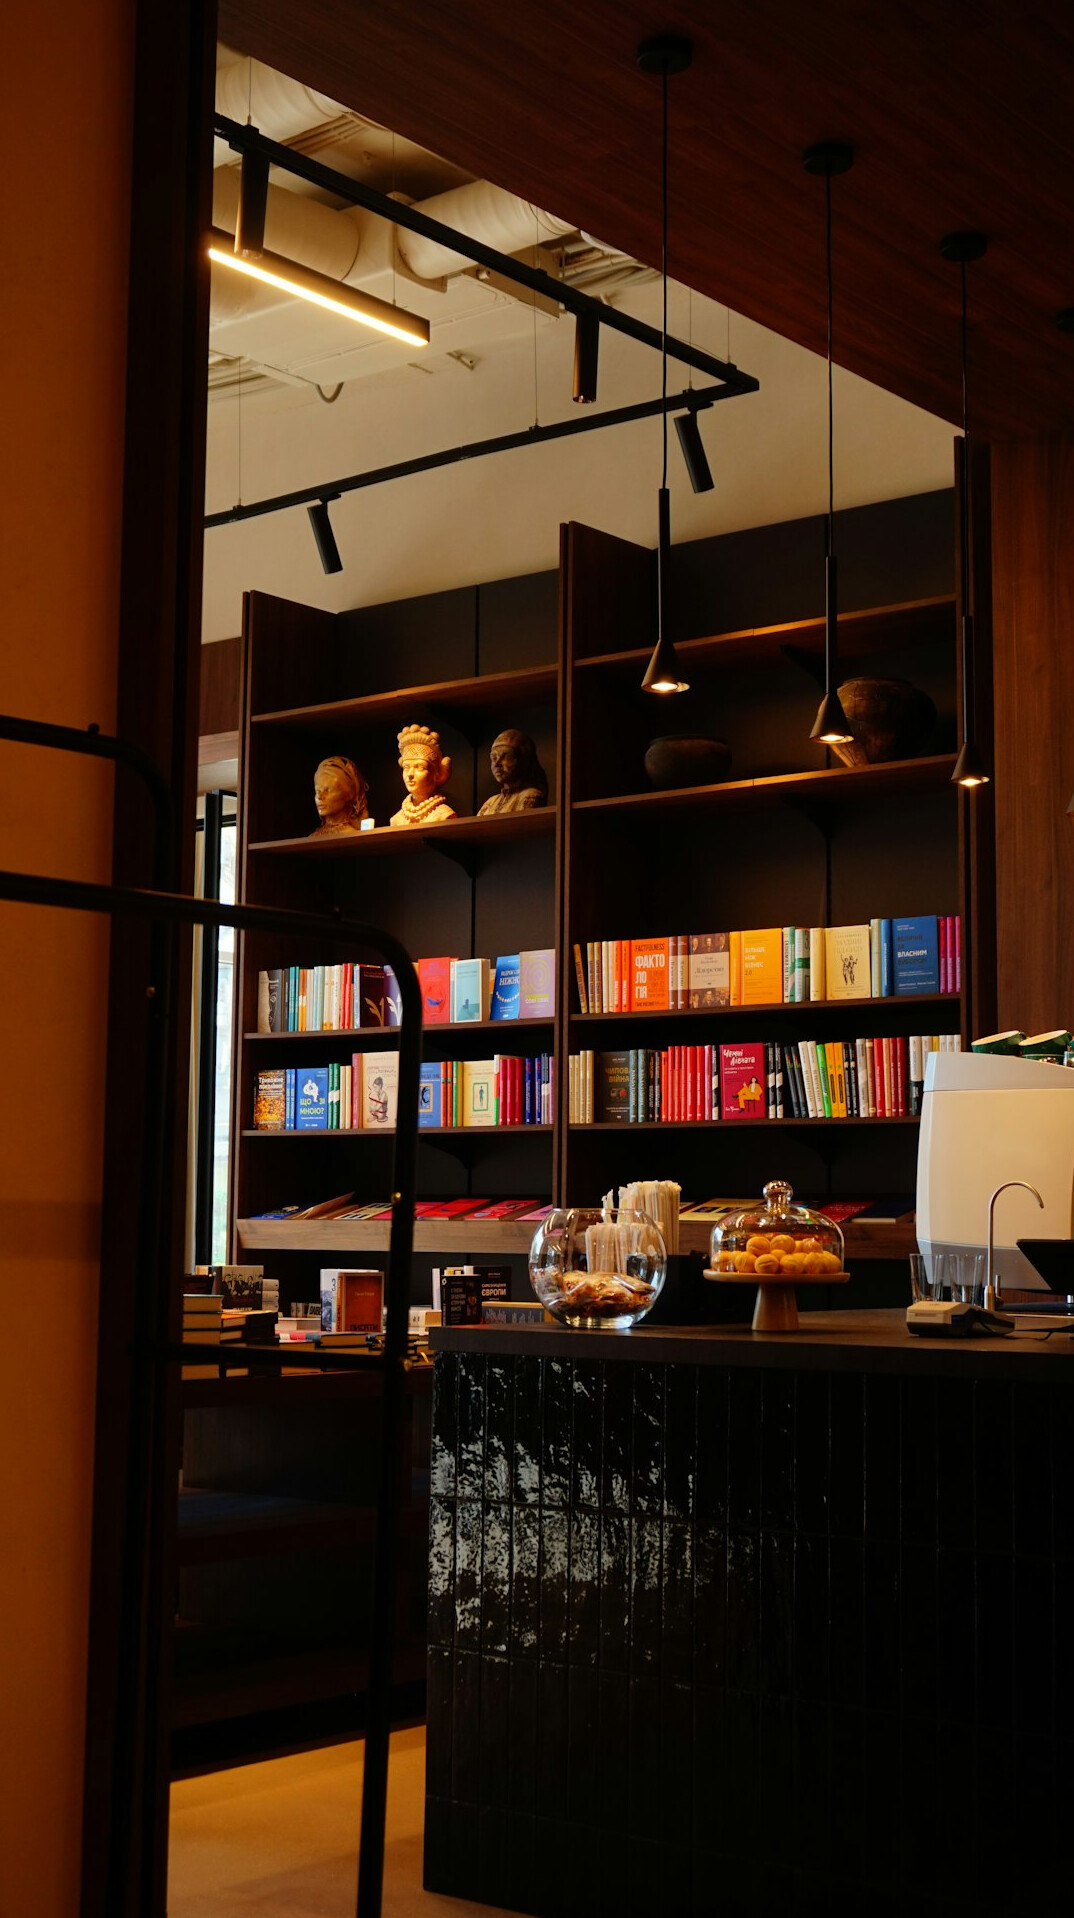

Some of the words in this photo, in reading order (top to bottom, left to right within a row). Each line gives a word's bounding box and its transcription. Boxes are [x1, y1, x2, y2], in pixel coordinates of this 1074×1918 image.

[897, 949, 928, 958] ВЛАСНИМ
[635, 953, 665, 969] ФАКТО
[635, 971, 647, 984] ЛО
[635, 985, 648, 999] ГІЯ
[605, 1067, 630, 1075] ЧИПОВ
[608, 1075, 630, 1083] ВІЙНА
[300, 1097, 312, 1106] ЩО
[319, 1096, 326, 1105] ЗІ
[300, 1107, 325, 1115] МНОЮ?
[481, 1288, 507, 1296] ЄВРОПИ
